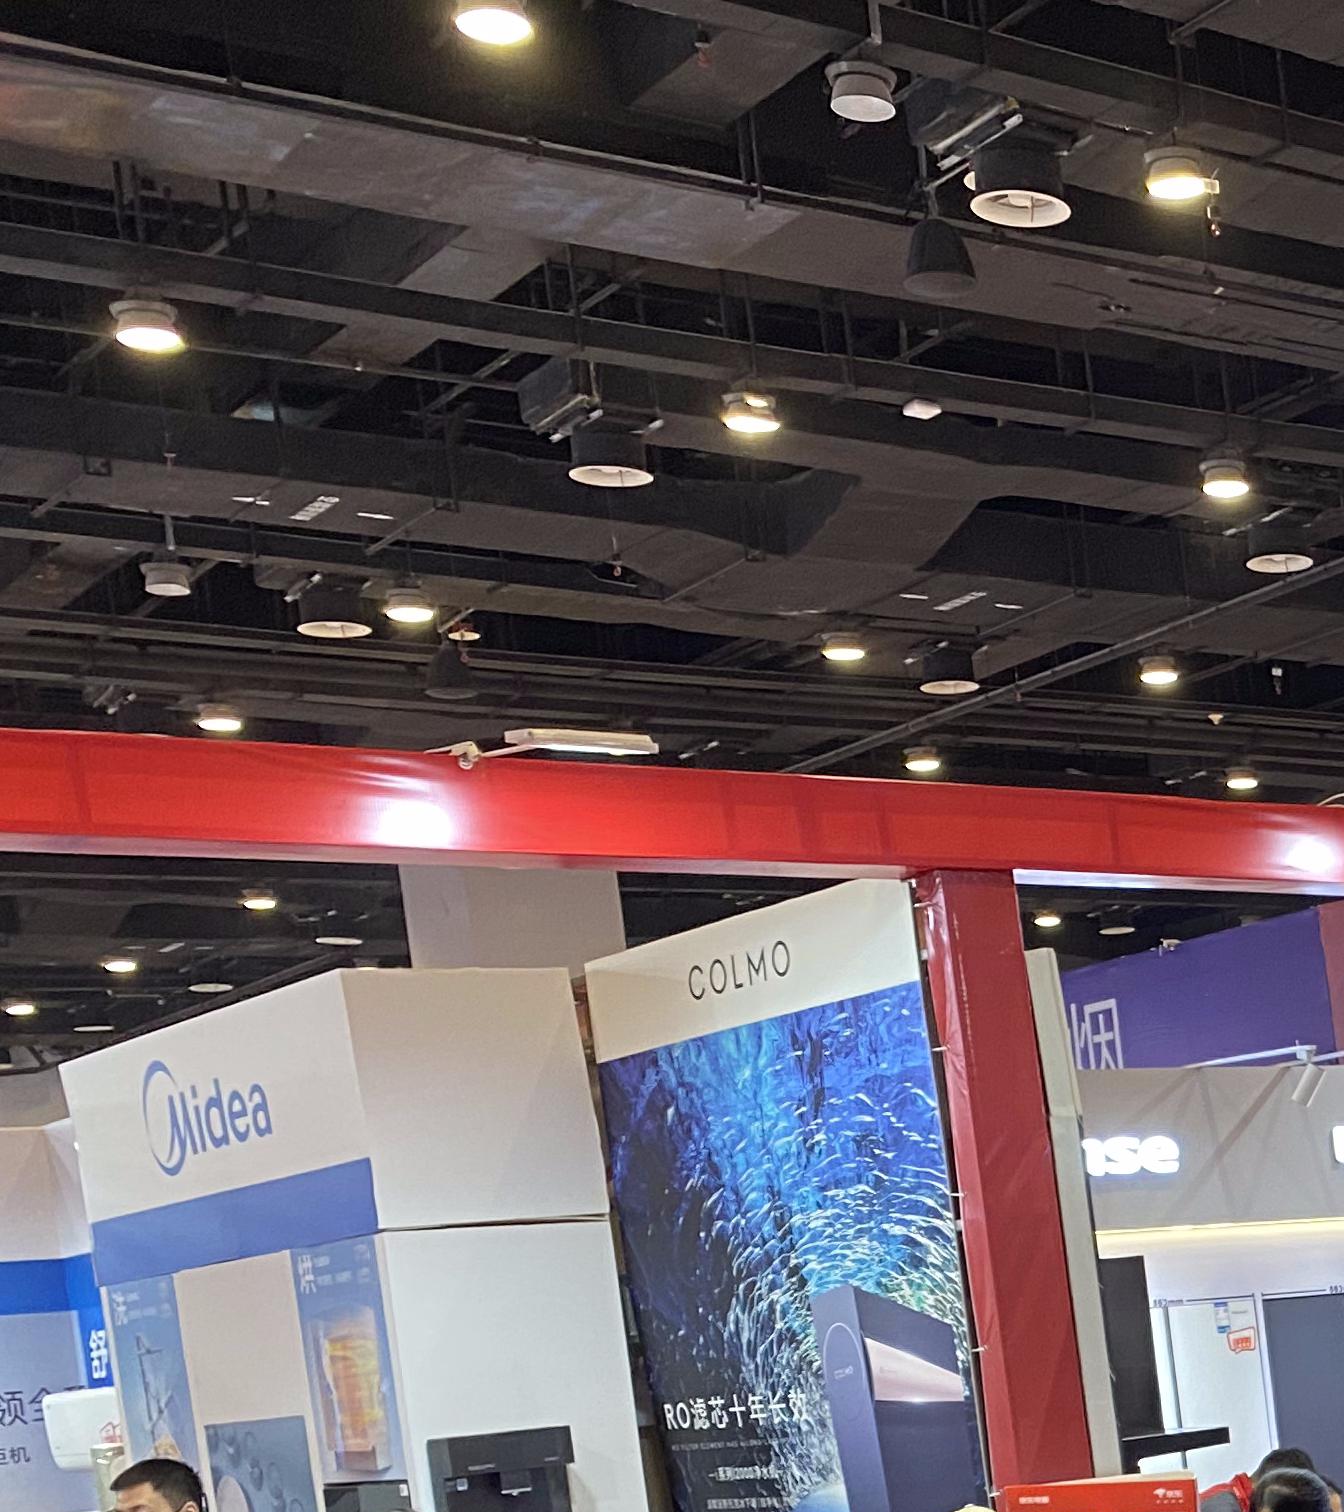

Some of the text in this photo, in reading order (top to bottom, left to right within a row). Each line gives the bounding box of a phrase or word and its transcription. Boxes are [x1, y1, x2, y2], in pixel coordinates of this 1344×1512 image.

[688, 940, 791, 1001] COLMO
[141, 1060, 273, 1177] Midea
[663, 1390, 808, 1431] RO滤芯十年长效
